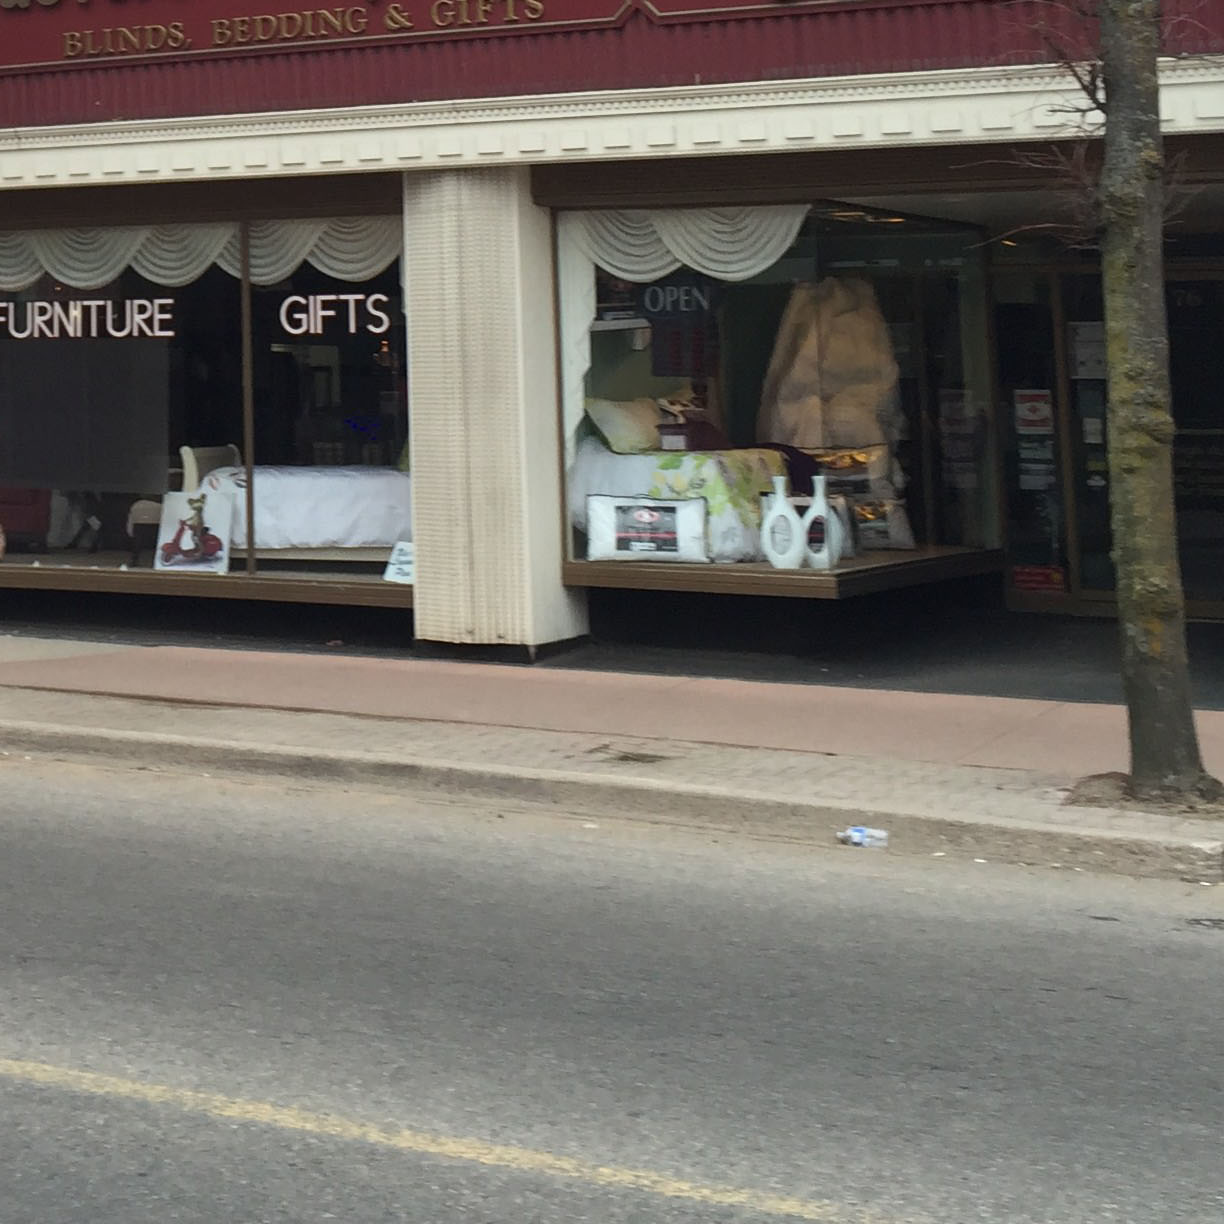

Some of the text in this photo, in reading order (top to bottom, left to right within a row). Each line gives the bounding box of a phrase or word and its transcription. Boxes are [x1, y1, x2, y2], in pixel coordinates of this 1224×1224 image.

[211, 6, 368, 45] BEDDING
[385, 3, 414, 31] &
[279, 293, 391, 335] GIFTS
[643, 285, 711, 313] OPEN
